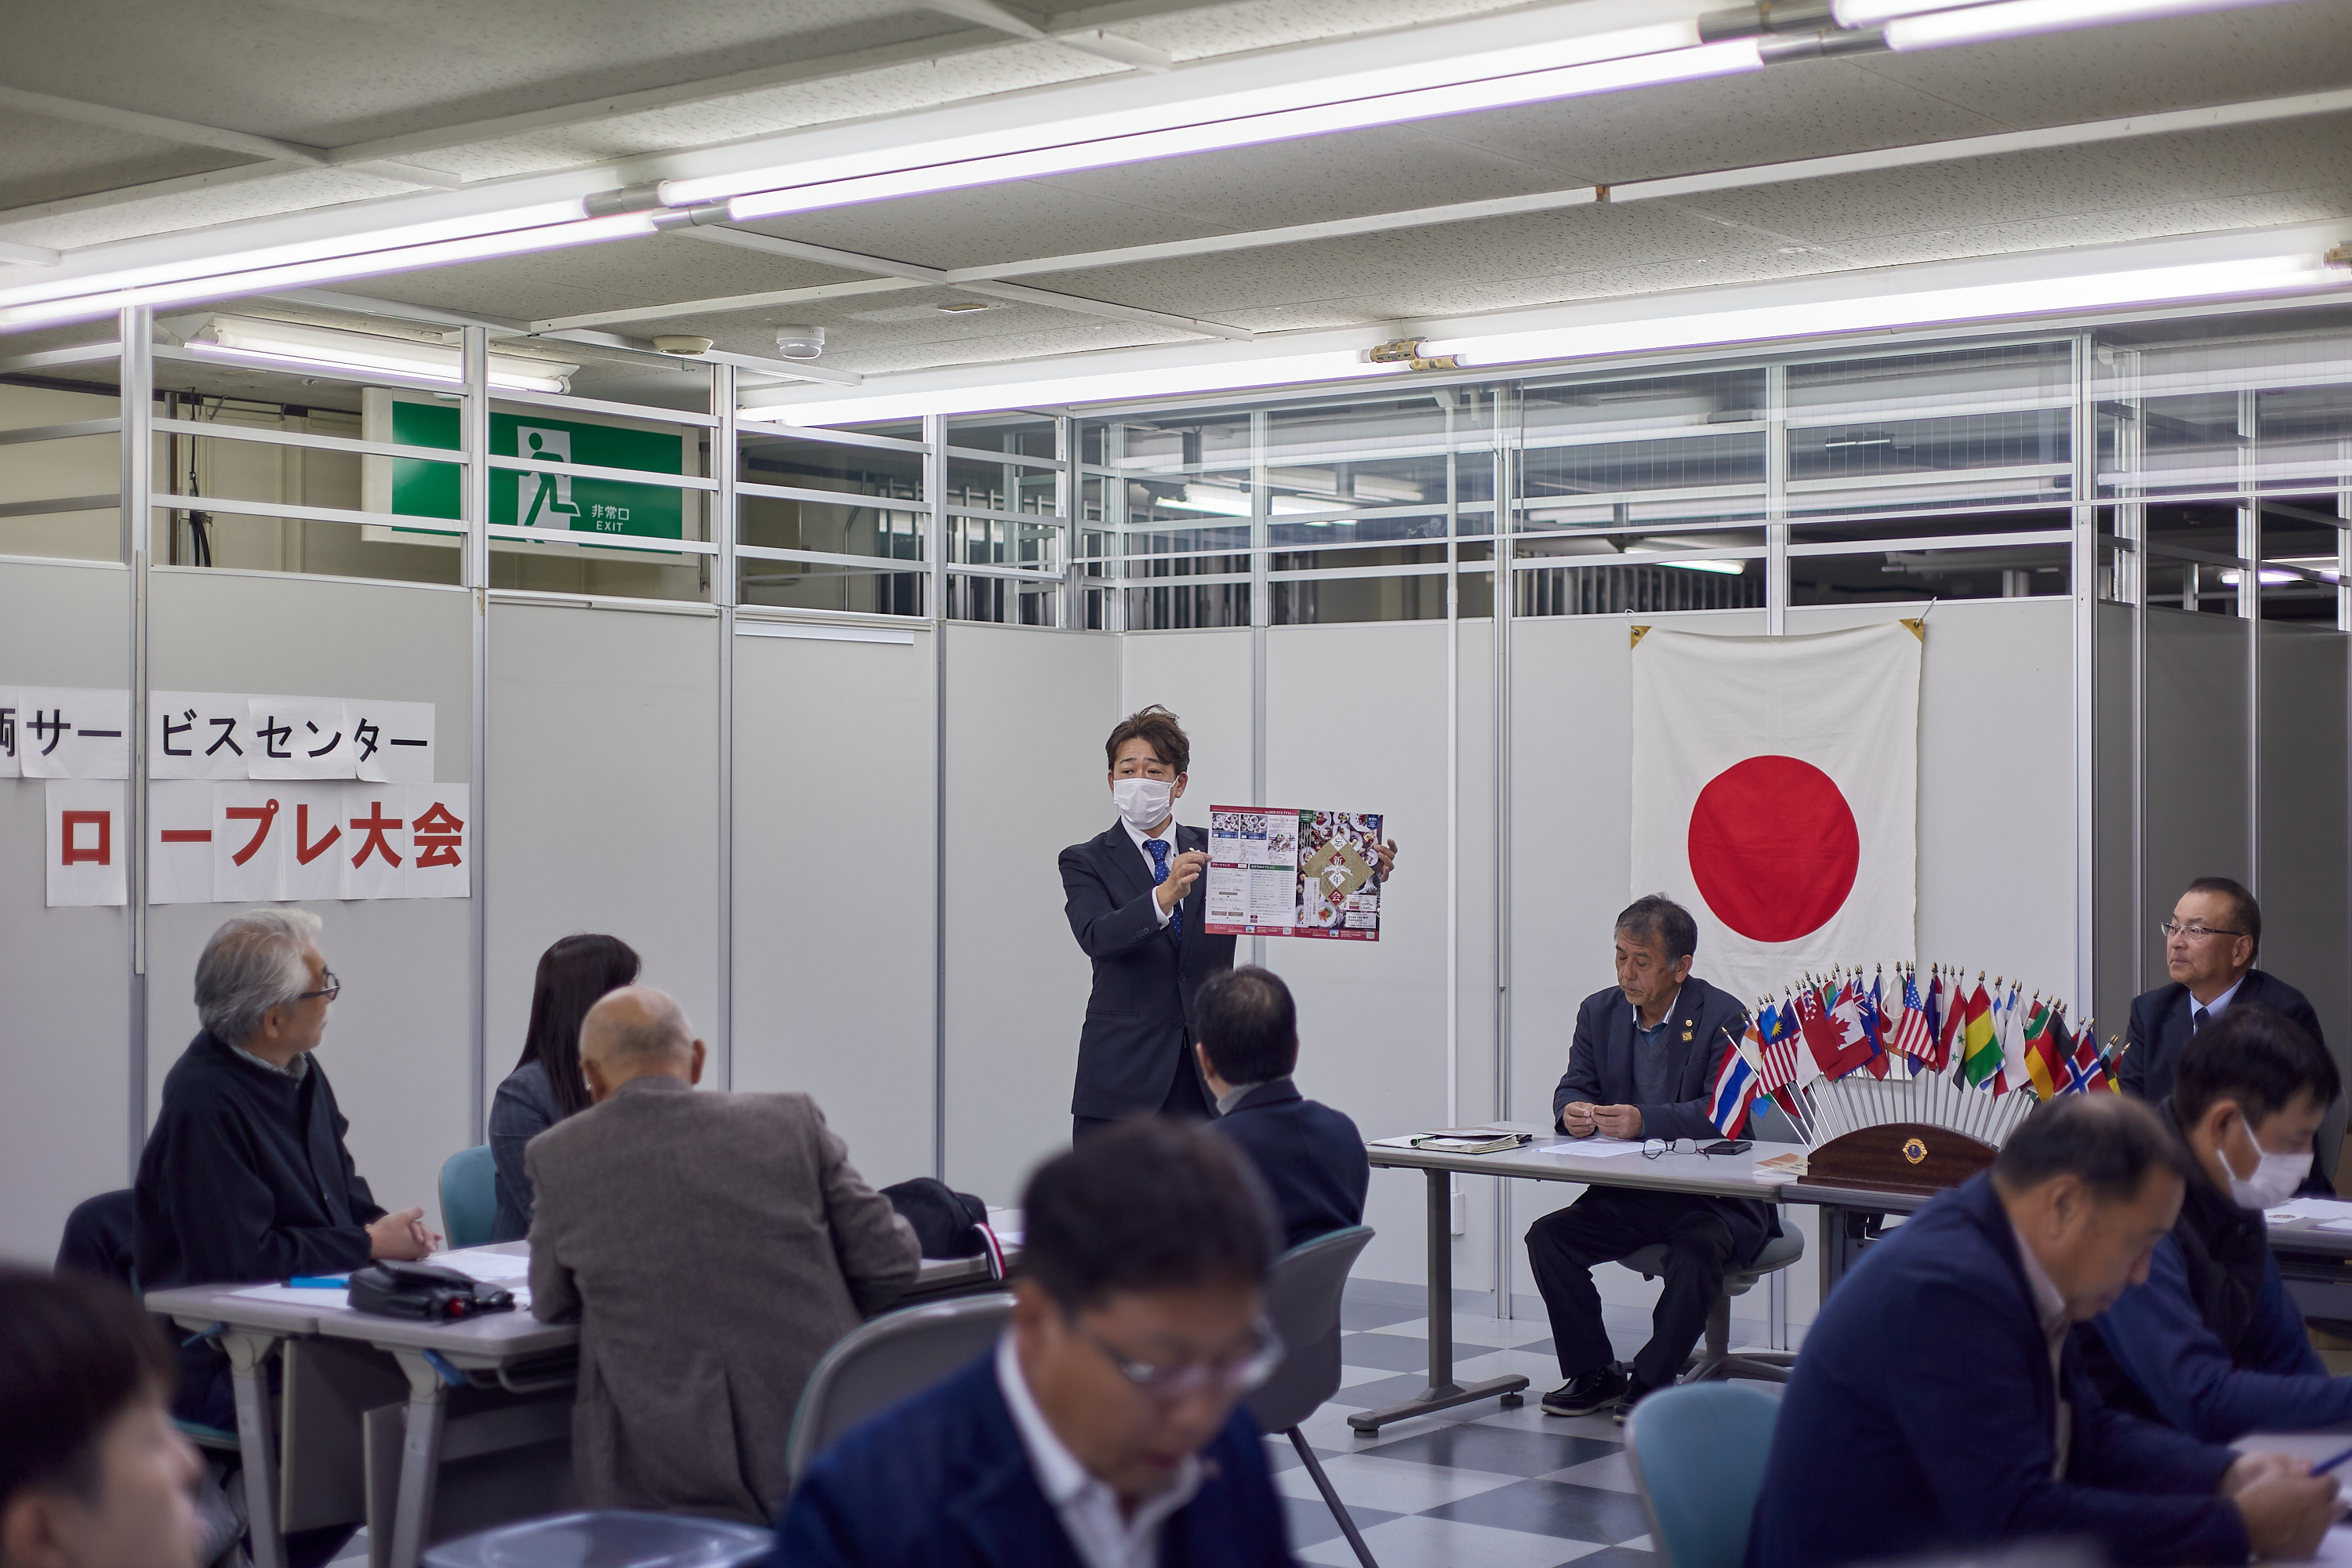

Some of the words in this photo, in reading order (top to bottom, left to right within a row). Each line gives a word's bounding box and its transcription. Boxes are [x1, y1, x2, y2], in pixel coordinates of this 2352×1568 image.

[591, 504, 629, 521] 非常口
[596, 521, 623, 532] EXIT
[62, 798, 464, 869] ロープレ大会
